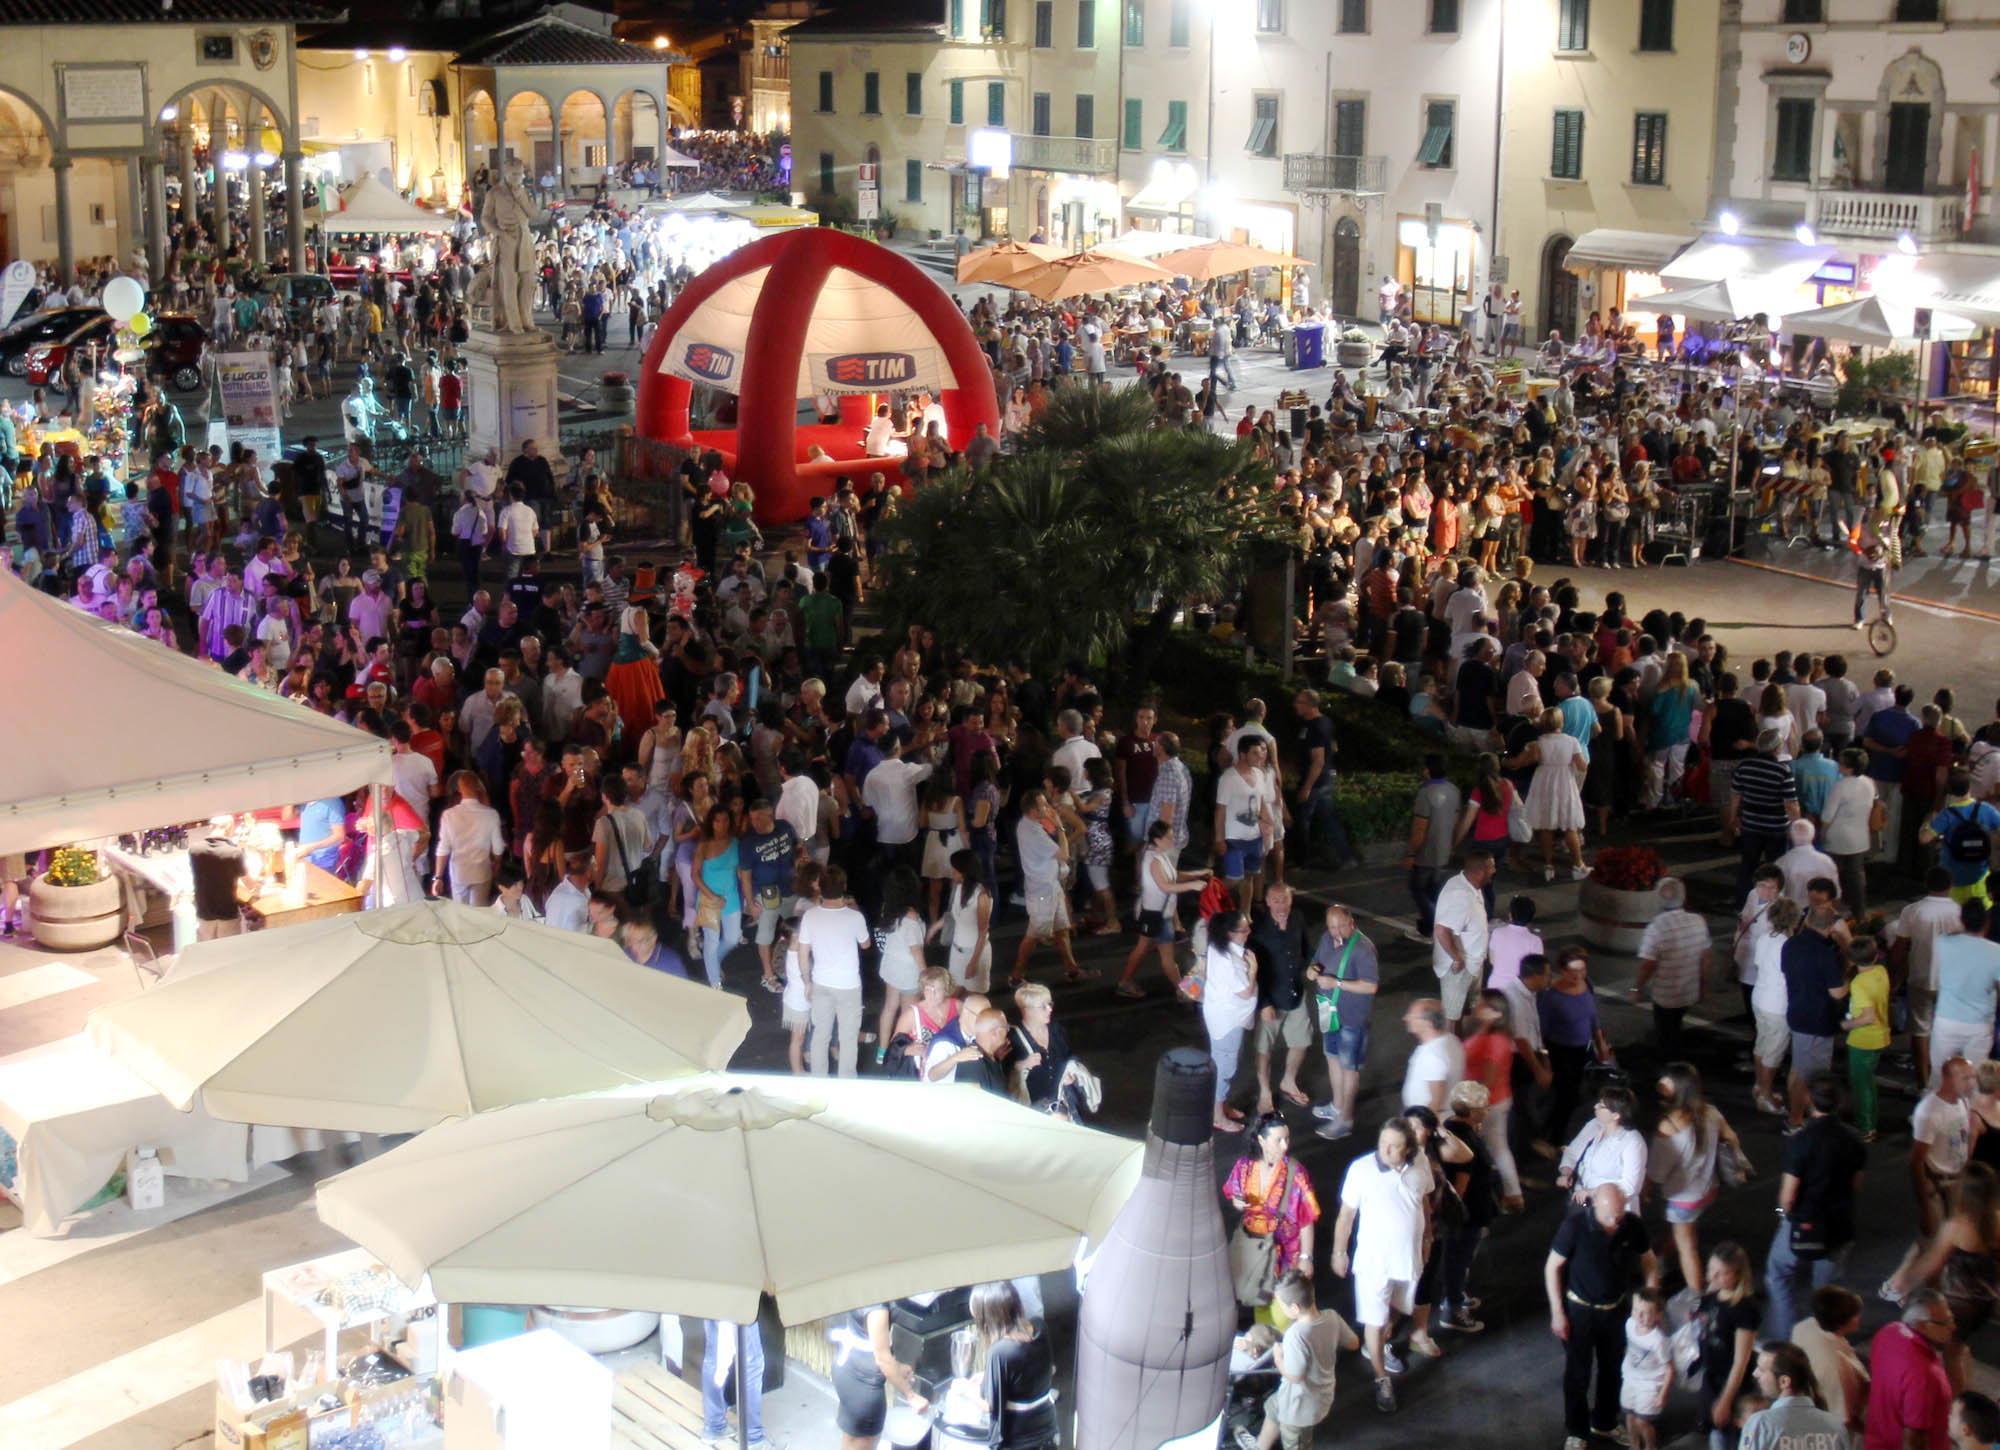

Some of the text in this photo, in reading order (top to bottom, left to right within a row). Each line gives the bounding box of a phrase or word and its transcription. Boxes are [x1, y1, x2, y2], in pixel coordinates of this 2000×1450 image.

[708, 352, 732, 376] TIM
[866, 358, 905, 380] TIM
[232, 371, 268, 381] LUGLIO
[1779, 1432, 1841, 1450] RUGBY
